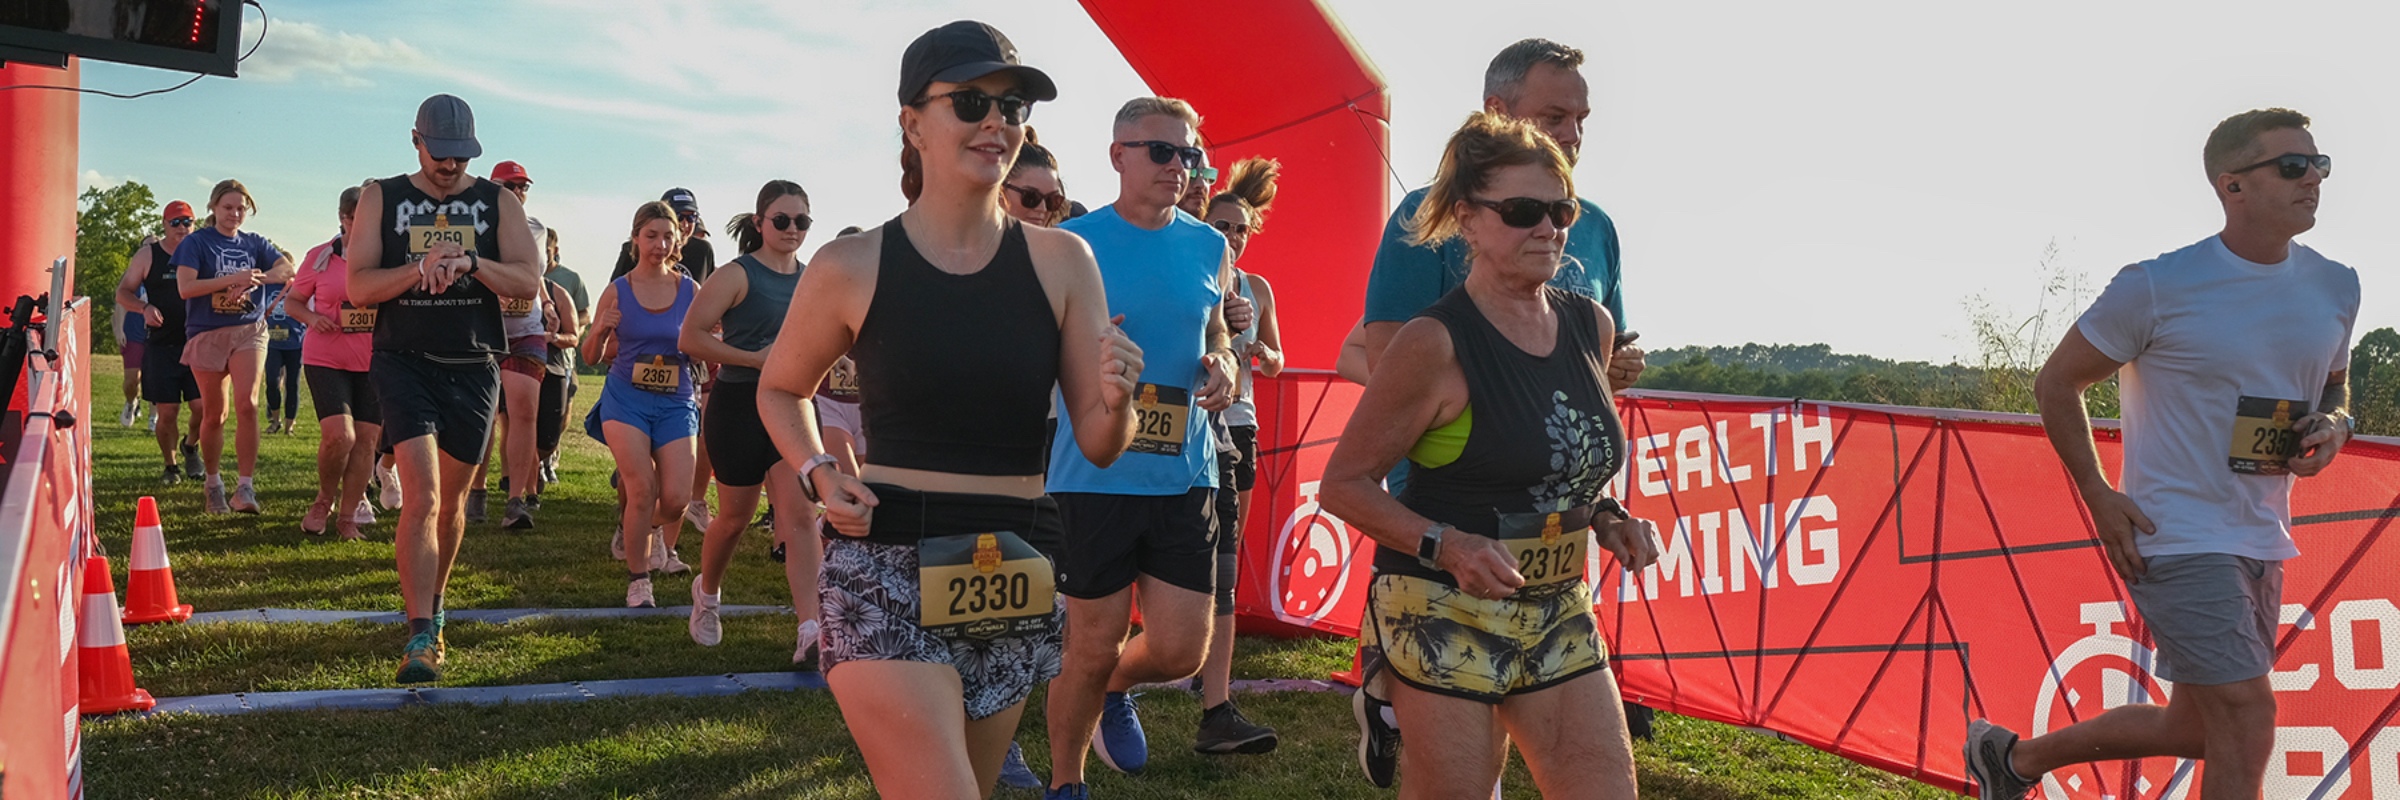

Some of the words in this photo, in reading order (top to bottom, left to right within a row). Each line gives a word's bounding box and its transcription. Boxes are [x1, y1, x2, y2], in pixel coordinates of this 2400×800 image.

[424, 230, 463, 248] 2359
[349, 312, 375, 325] 2301
[642, 367, 672, 384] 2367
[1136, 408, 1172, 437] 326
[1592, 415, 1605, 432] FP
[2251, 426, 2291, 456] 235
[1519, 542, 1575, 580] 2312
[948, 571, 1029, 616] 2330
